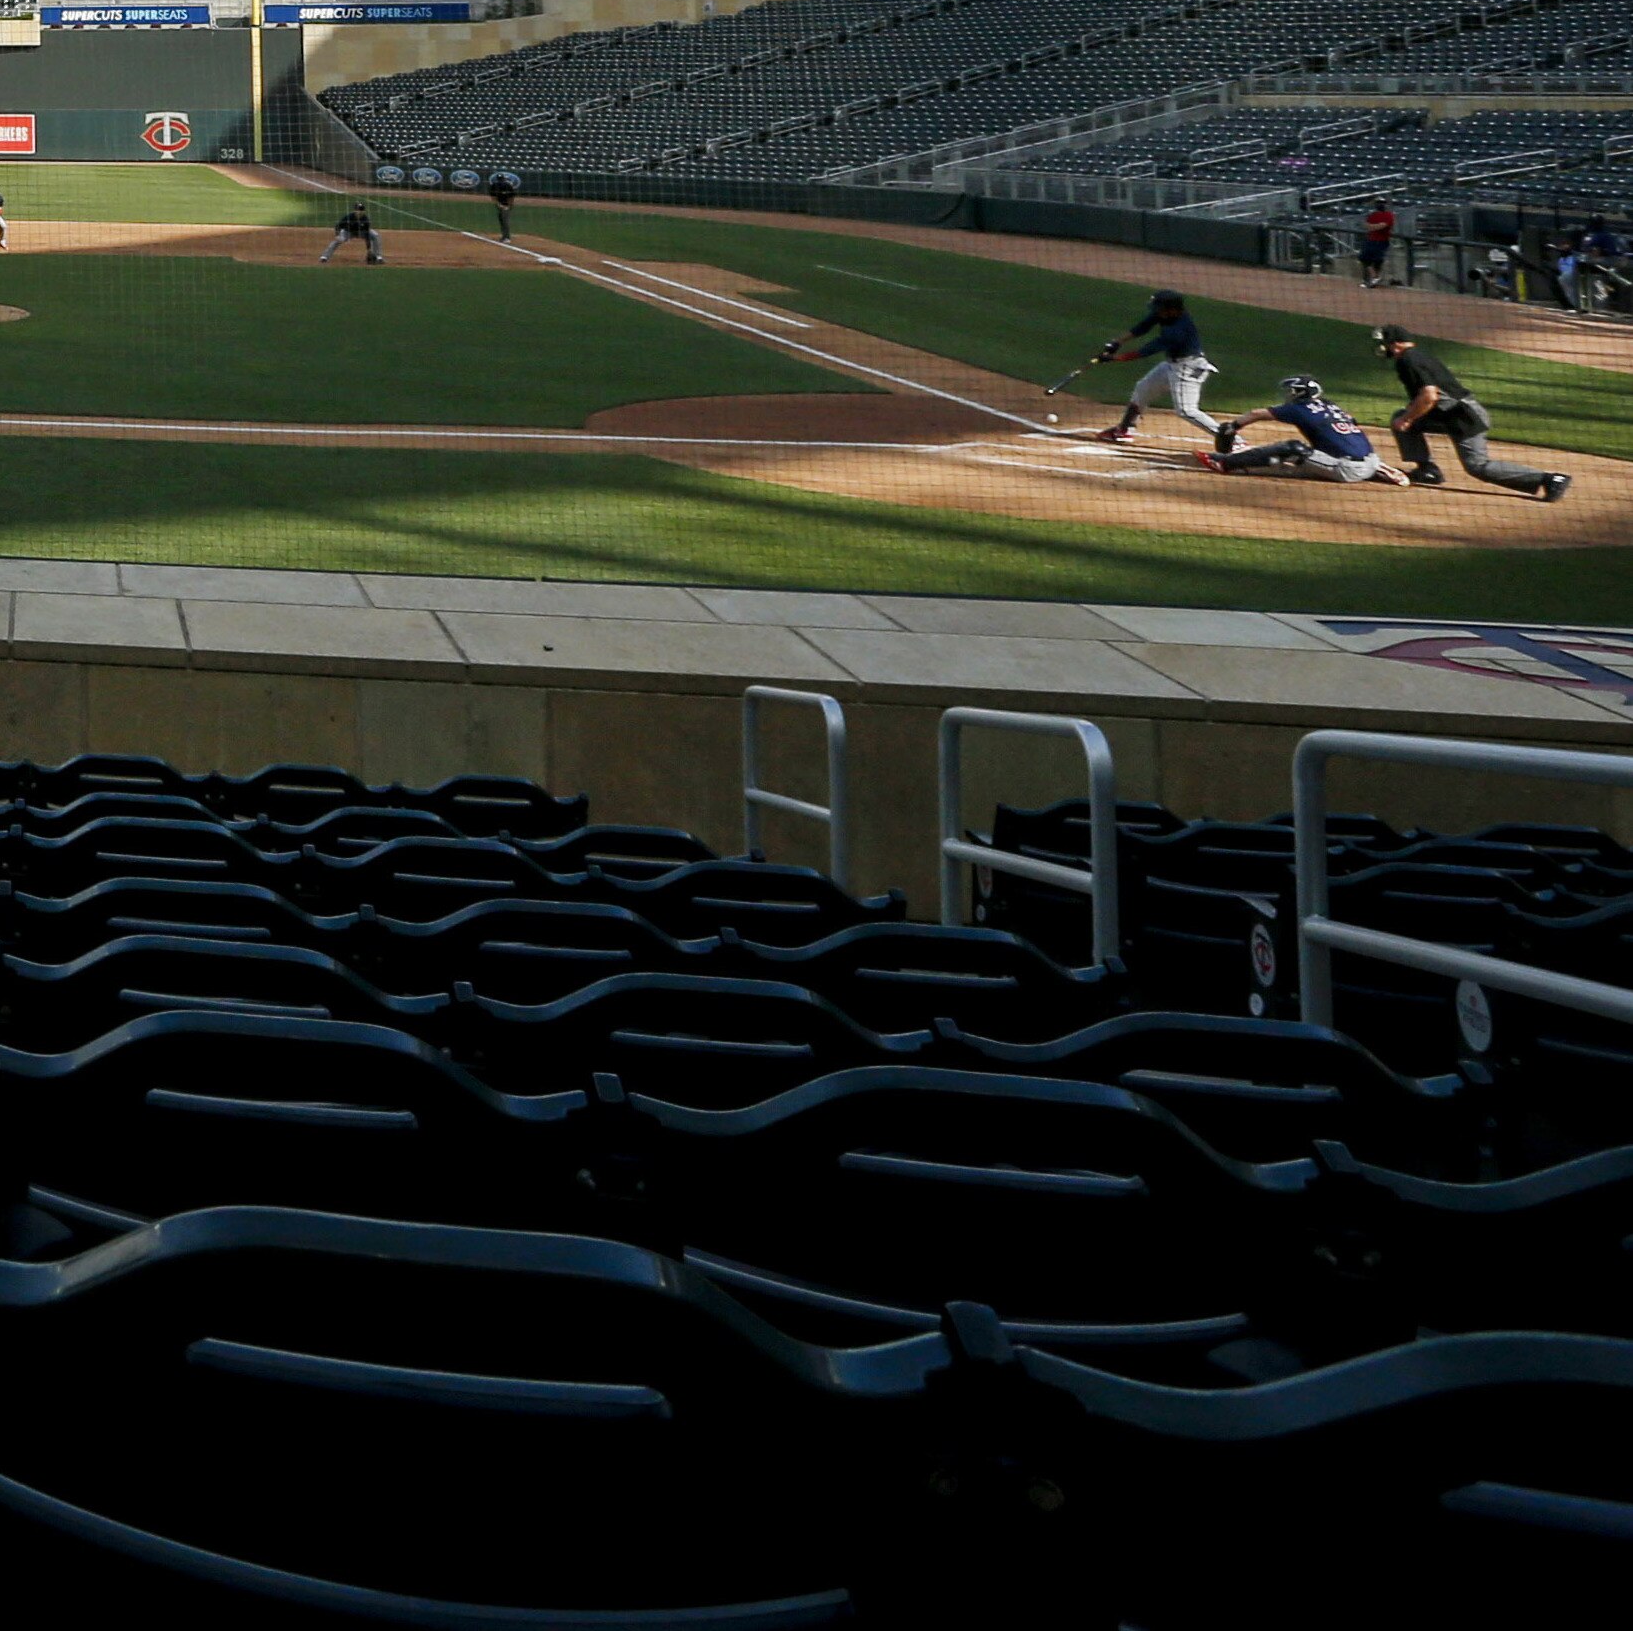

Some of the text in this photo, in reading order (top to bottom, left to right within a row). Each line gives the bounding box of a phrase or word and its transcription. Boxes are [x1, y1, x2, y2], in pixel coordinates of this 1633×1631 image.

[61, 9, 187, 22] SUPERCUTS SUPERSEATS
[299, 7, 433, 20] SUPERCUTS SUPERSEATS
[220, 149, 244, 159] 328
